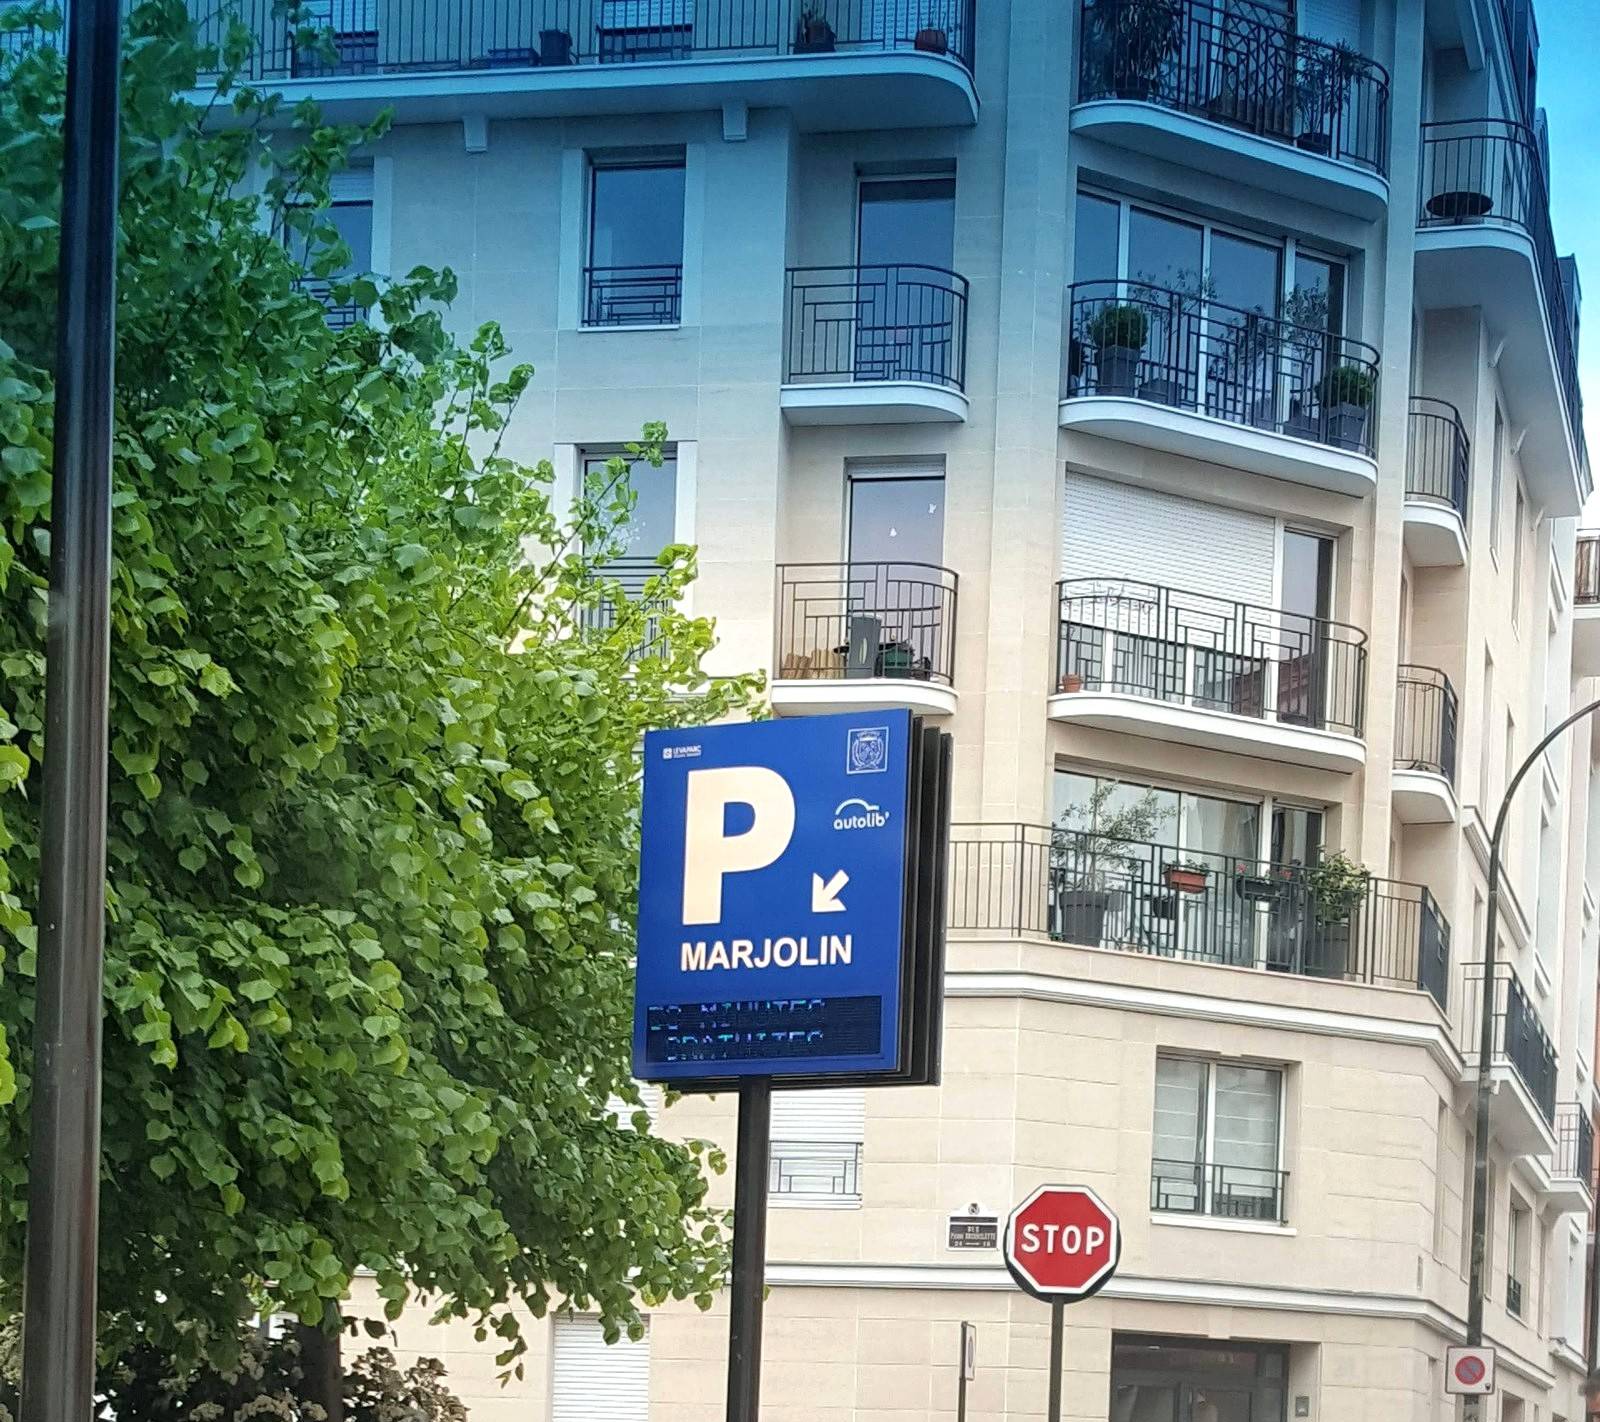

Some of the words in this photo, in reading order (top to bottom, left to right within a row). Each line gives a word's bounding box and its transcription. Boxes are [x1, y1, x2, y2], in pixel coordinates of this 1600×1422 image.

[682, 766, 796, 926] P
[680, 935, 852, 972] MARJOLIN
[1021, 1223, 1105, 1256] STOP
